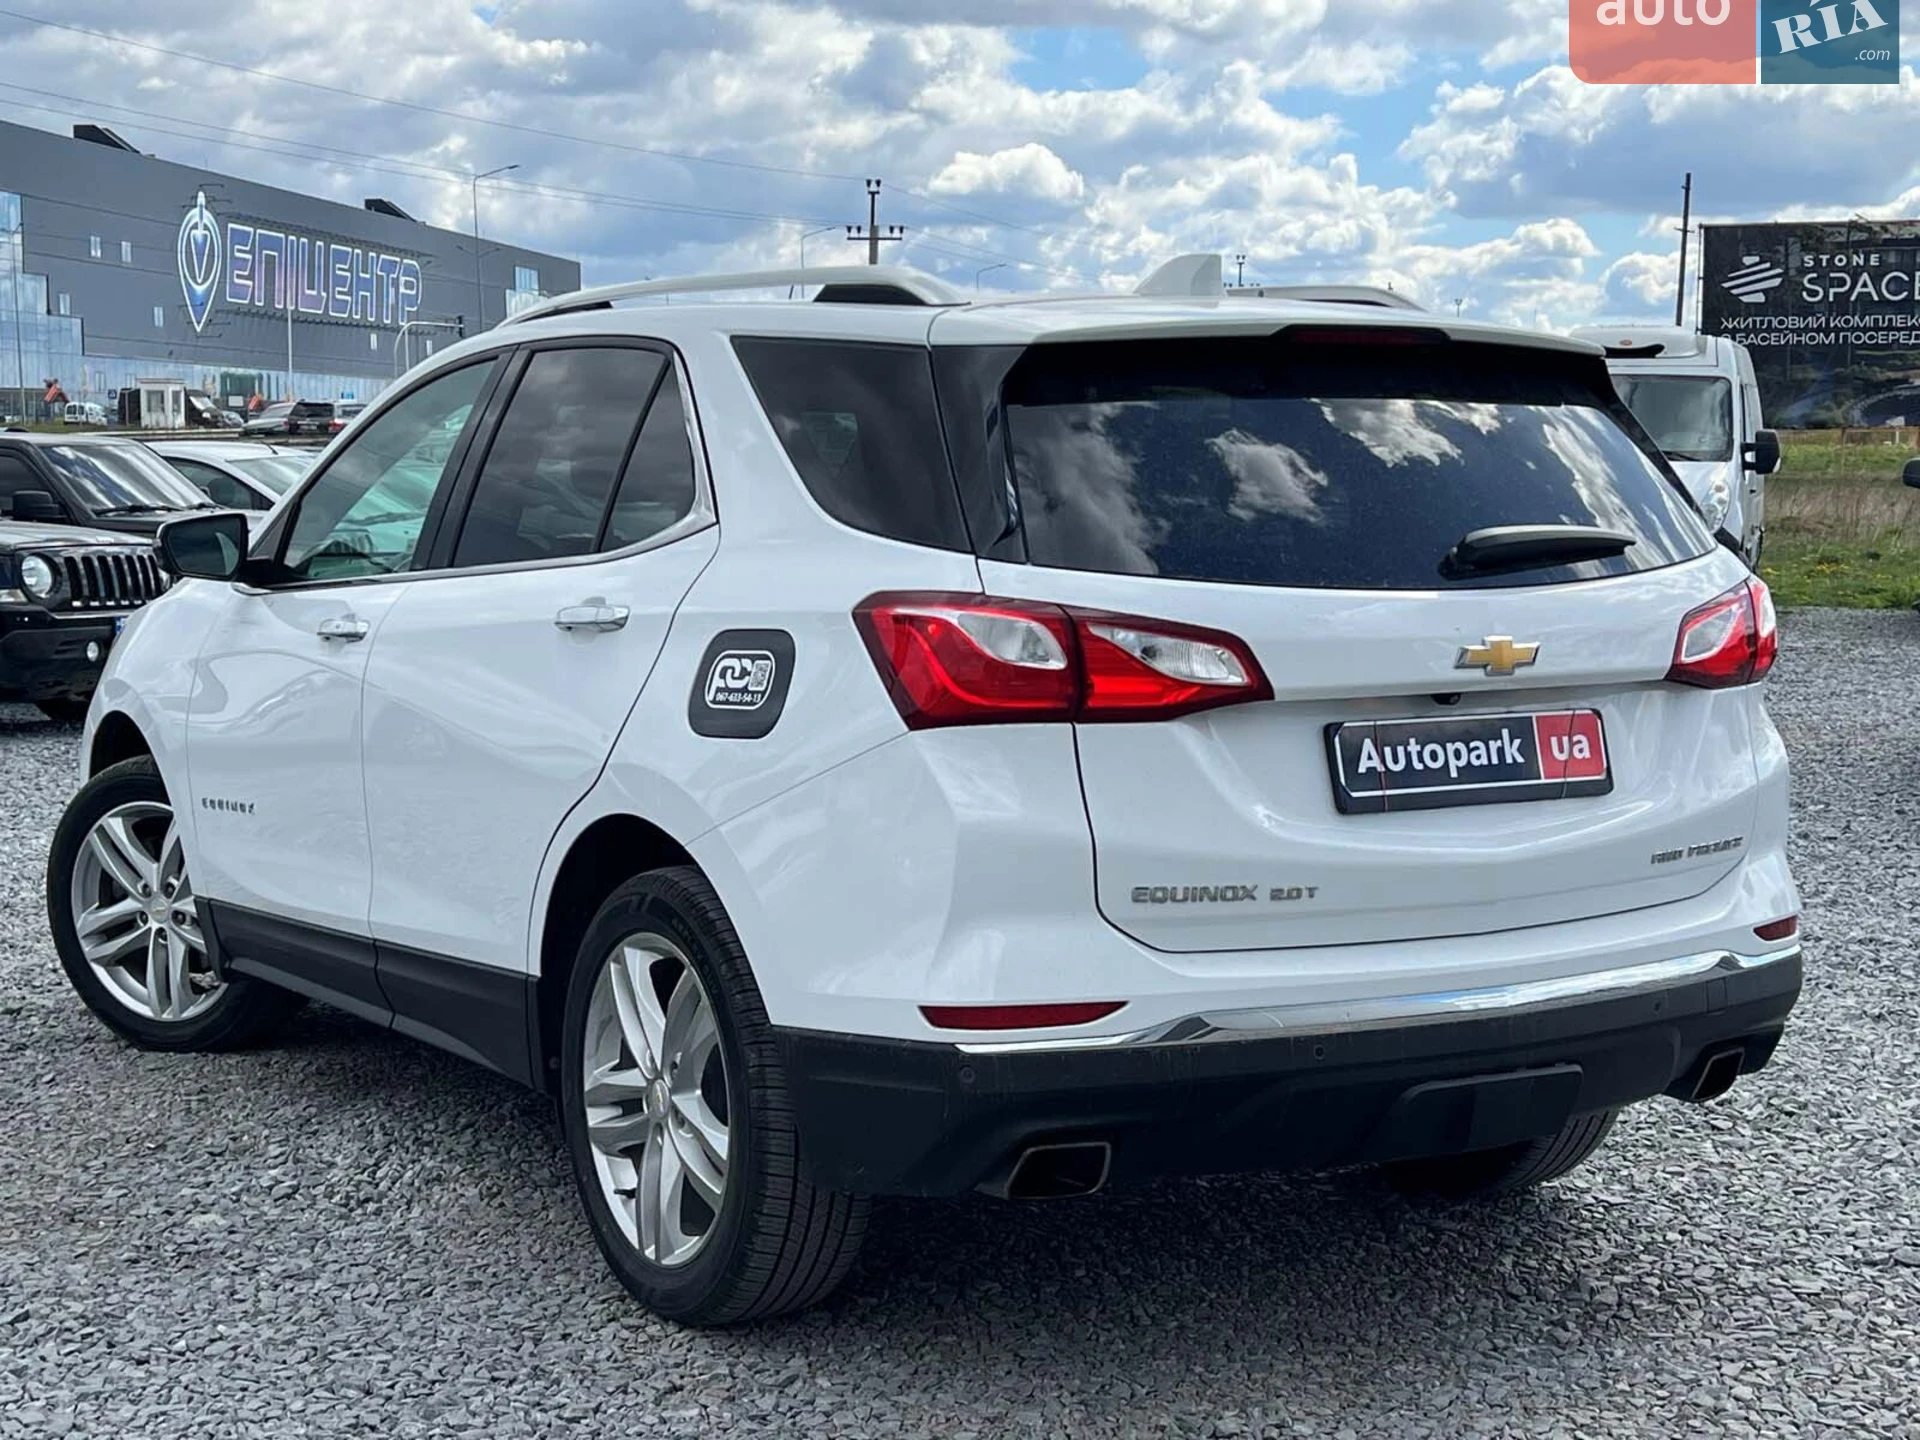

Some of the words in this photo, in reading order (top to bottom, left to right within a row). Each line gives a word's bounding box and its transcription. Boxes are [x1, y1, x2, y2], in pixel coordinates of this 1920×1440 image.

[1804, 253, 1881, 267] STONE
[226, 223, 422, 326] ЕПІЦЕНТР
[1720, 313, 1826, 330] ЖИТЛОВИЙ
[1830, 314, 1920, 329] КОМПЛЕК
[1735, 330, 1835, 346] БАСЕЙНОМ
[1357, 728, 1526, 779] Autopark
[1550, 734, 1591, 762] ua
[1131, 884, 1258, 904] EQUINOX
